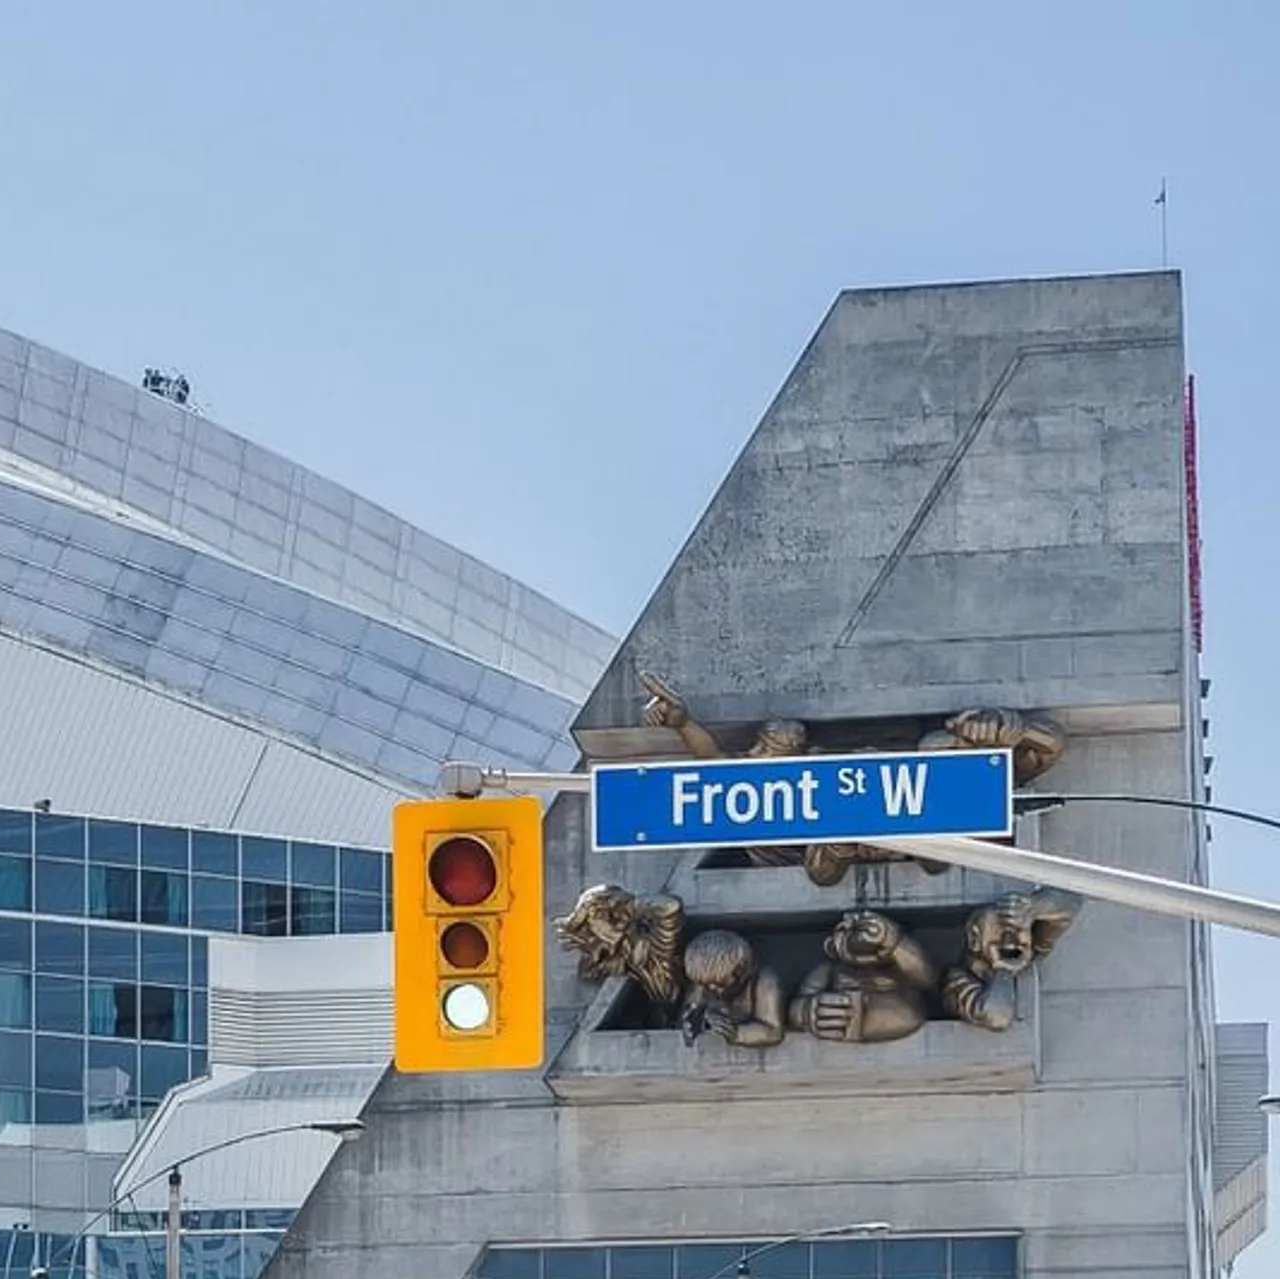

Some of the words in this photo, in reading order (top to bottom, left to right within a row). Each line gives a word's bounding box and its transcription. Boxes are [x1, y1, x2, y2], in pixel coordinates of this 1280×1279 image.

[671, 770, 820, 826] Front
[837, 767, 868, 796] St
[879, 763, 928, 816] W
